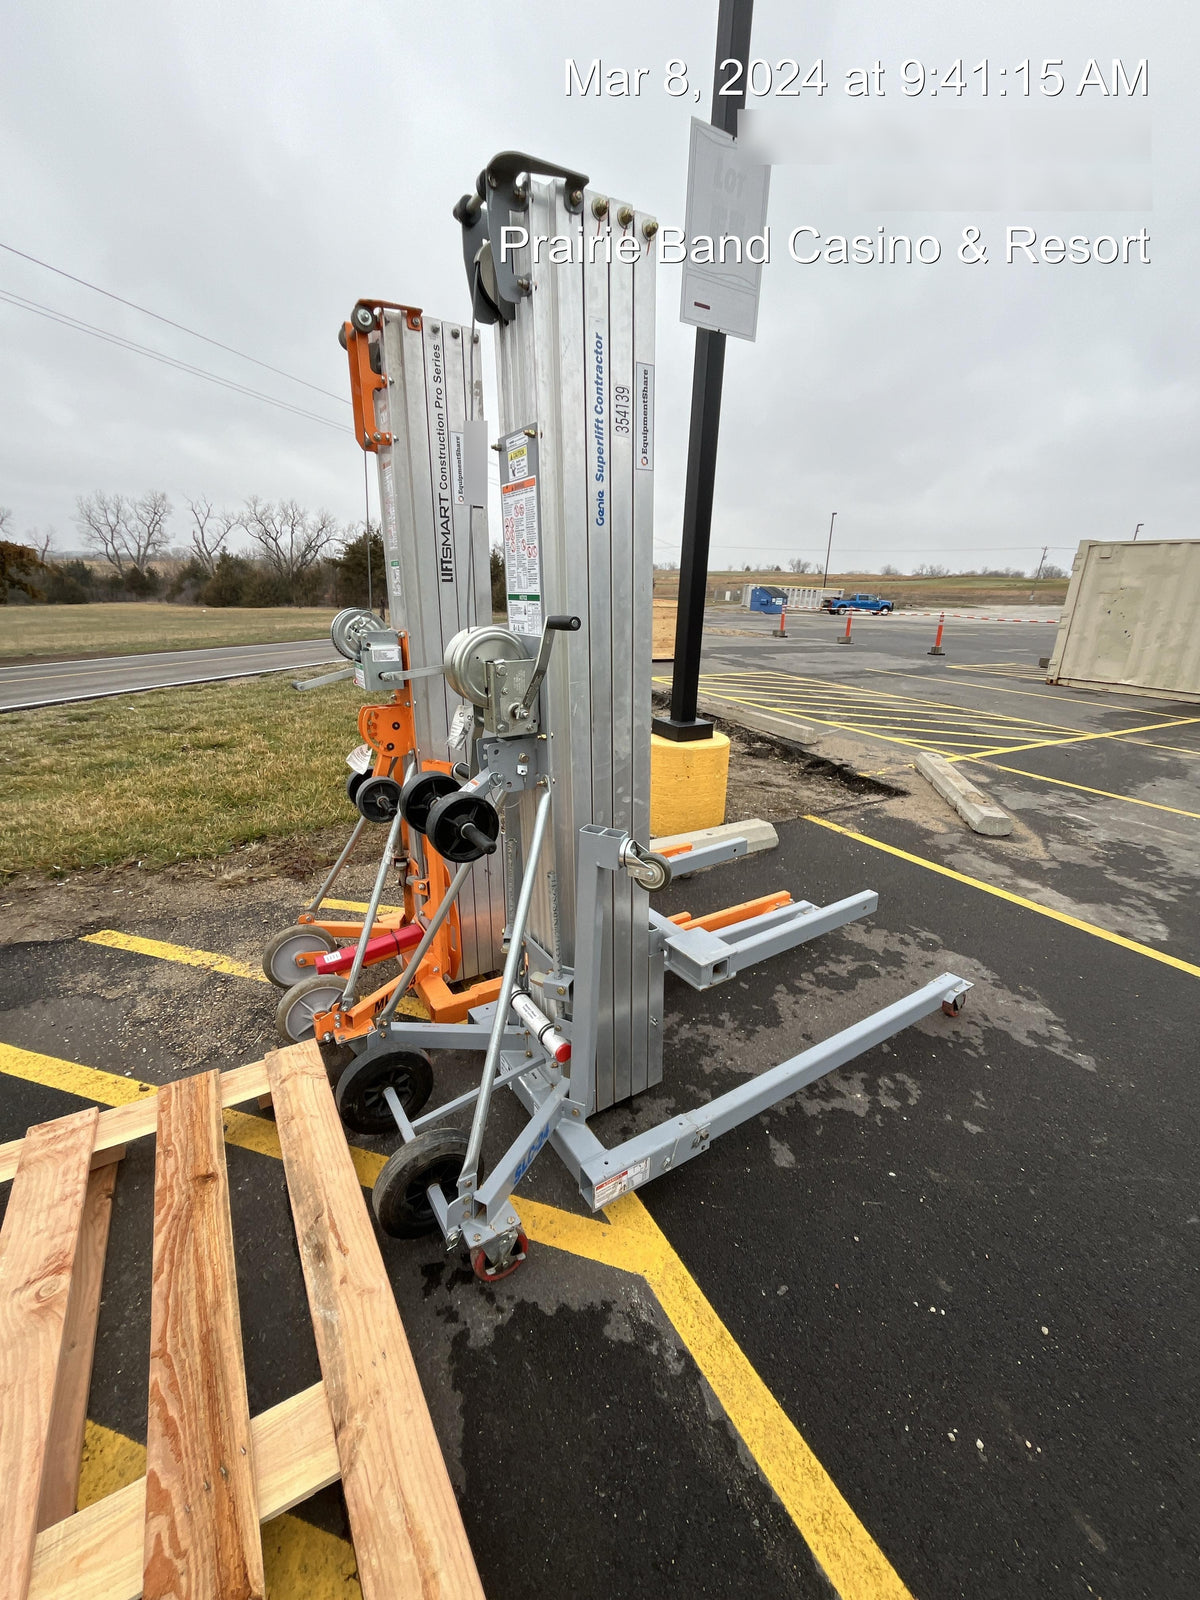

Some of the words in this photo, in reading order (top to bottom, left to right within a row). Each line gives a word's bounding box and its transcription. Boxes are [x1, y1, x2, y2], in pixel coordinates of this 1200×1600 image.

[433, 344, 442, 384] Series
[594, 332, 604, 414] Contractor
[434, 387, 443, 410] Pro
[616, 386, 630, 434] 354139
[436, 412, 448, 489] Construction
[595, 417, 605, 482] Superlift
[595, 490, 605, 527] Genie
[514, 1122, 550, 1185] SLC-24
